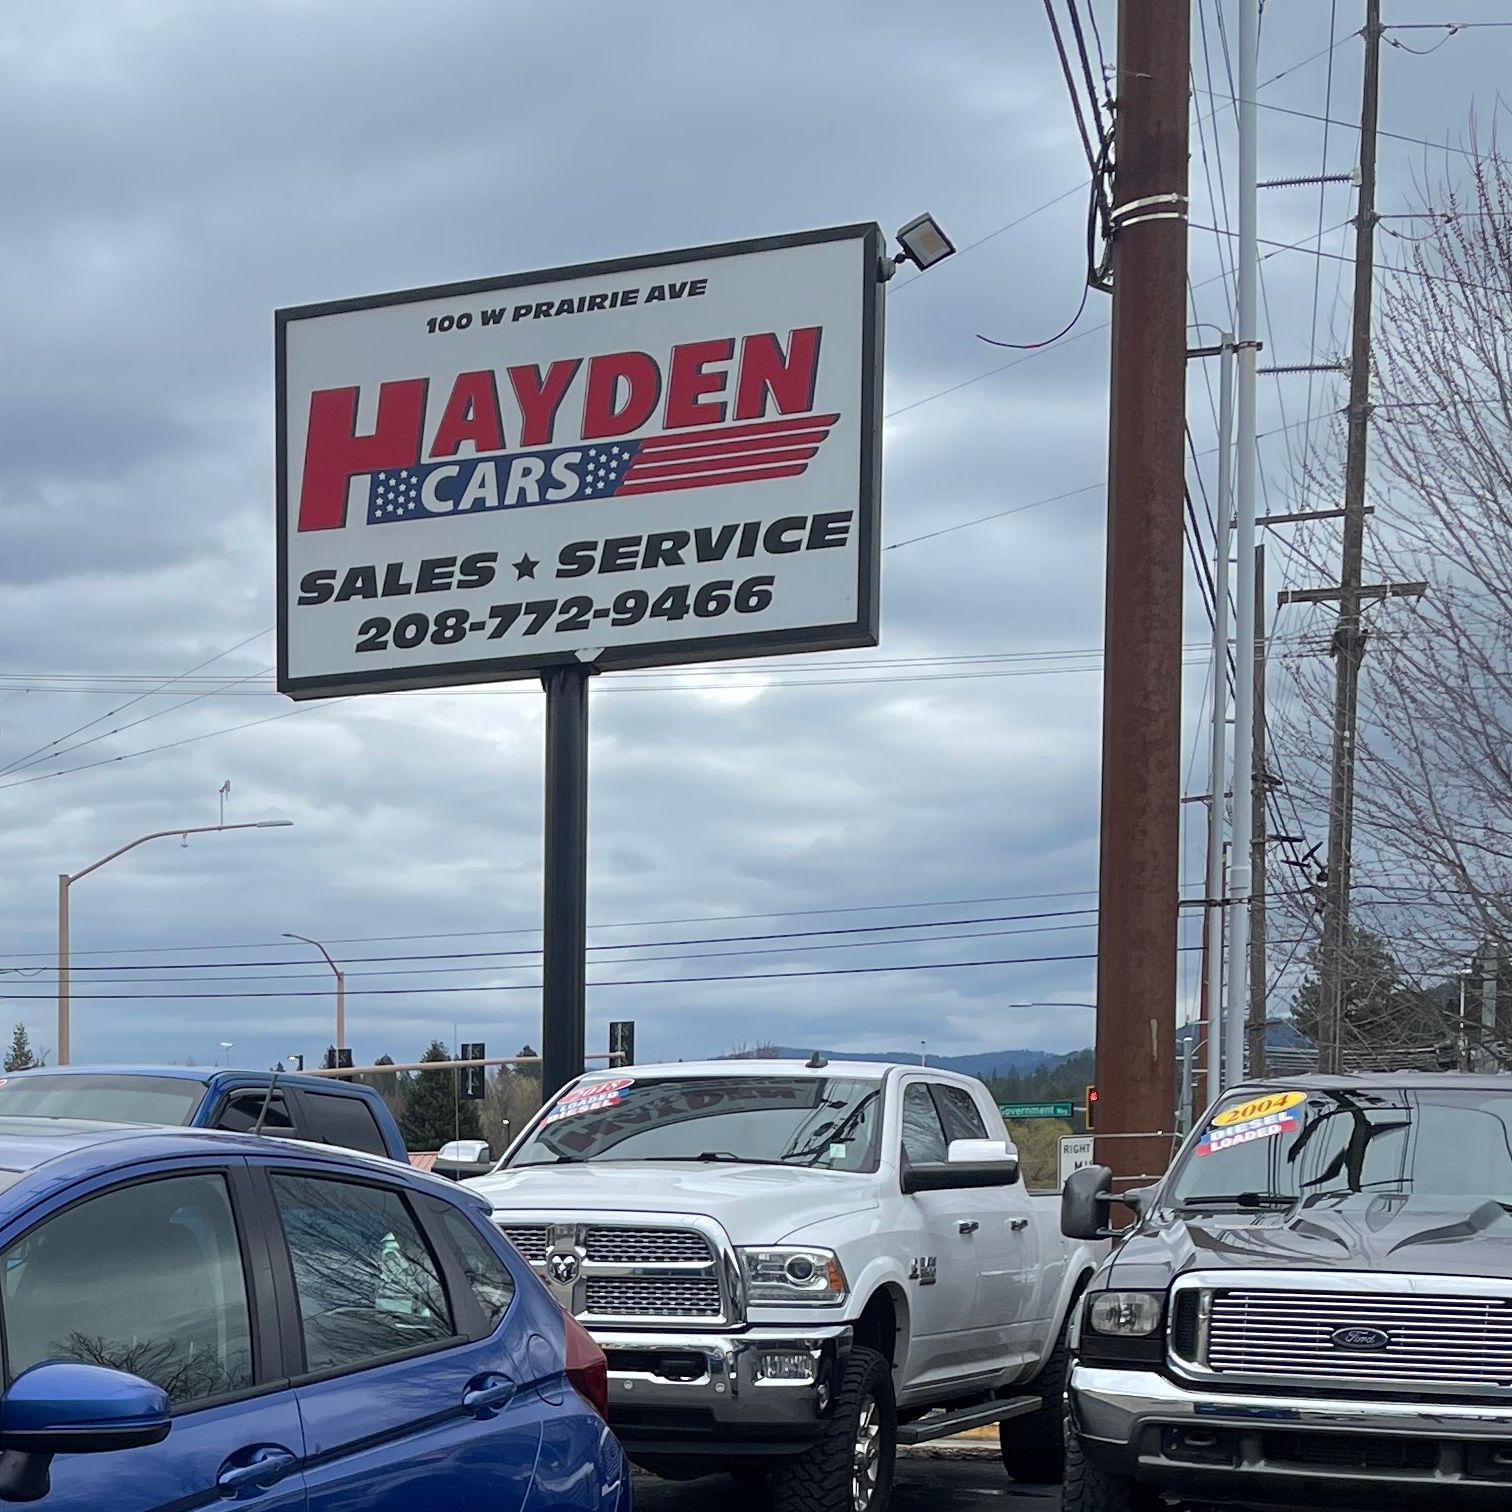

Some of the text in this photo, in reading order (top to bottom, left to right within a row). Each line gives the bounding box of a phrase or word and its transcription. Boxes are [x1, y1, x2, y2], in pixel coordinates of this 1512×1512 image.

[426, 277, 709, 335] 100 W PRAIRIE AVE
[297, 325, 824, 533] HAYDEN
[420, 450, 584, 514] CARS
[297, 510, 854, 606] SALES SERVICE
[354, 575, 776, 654] 208-772-9466
[1209, 1111, 1294, 1141] DIESEL
[1210, 1124, 1283, 1152] LOADED
[1225, 1094, 1289, 1124] 2004
[1063, 1143, 1091, 1154] RIGHT
